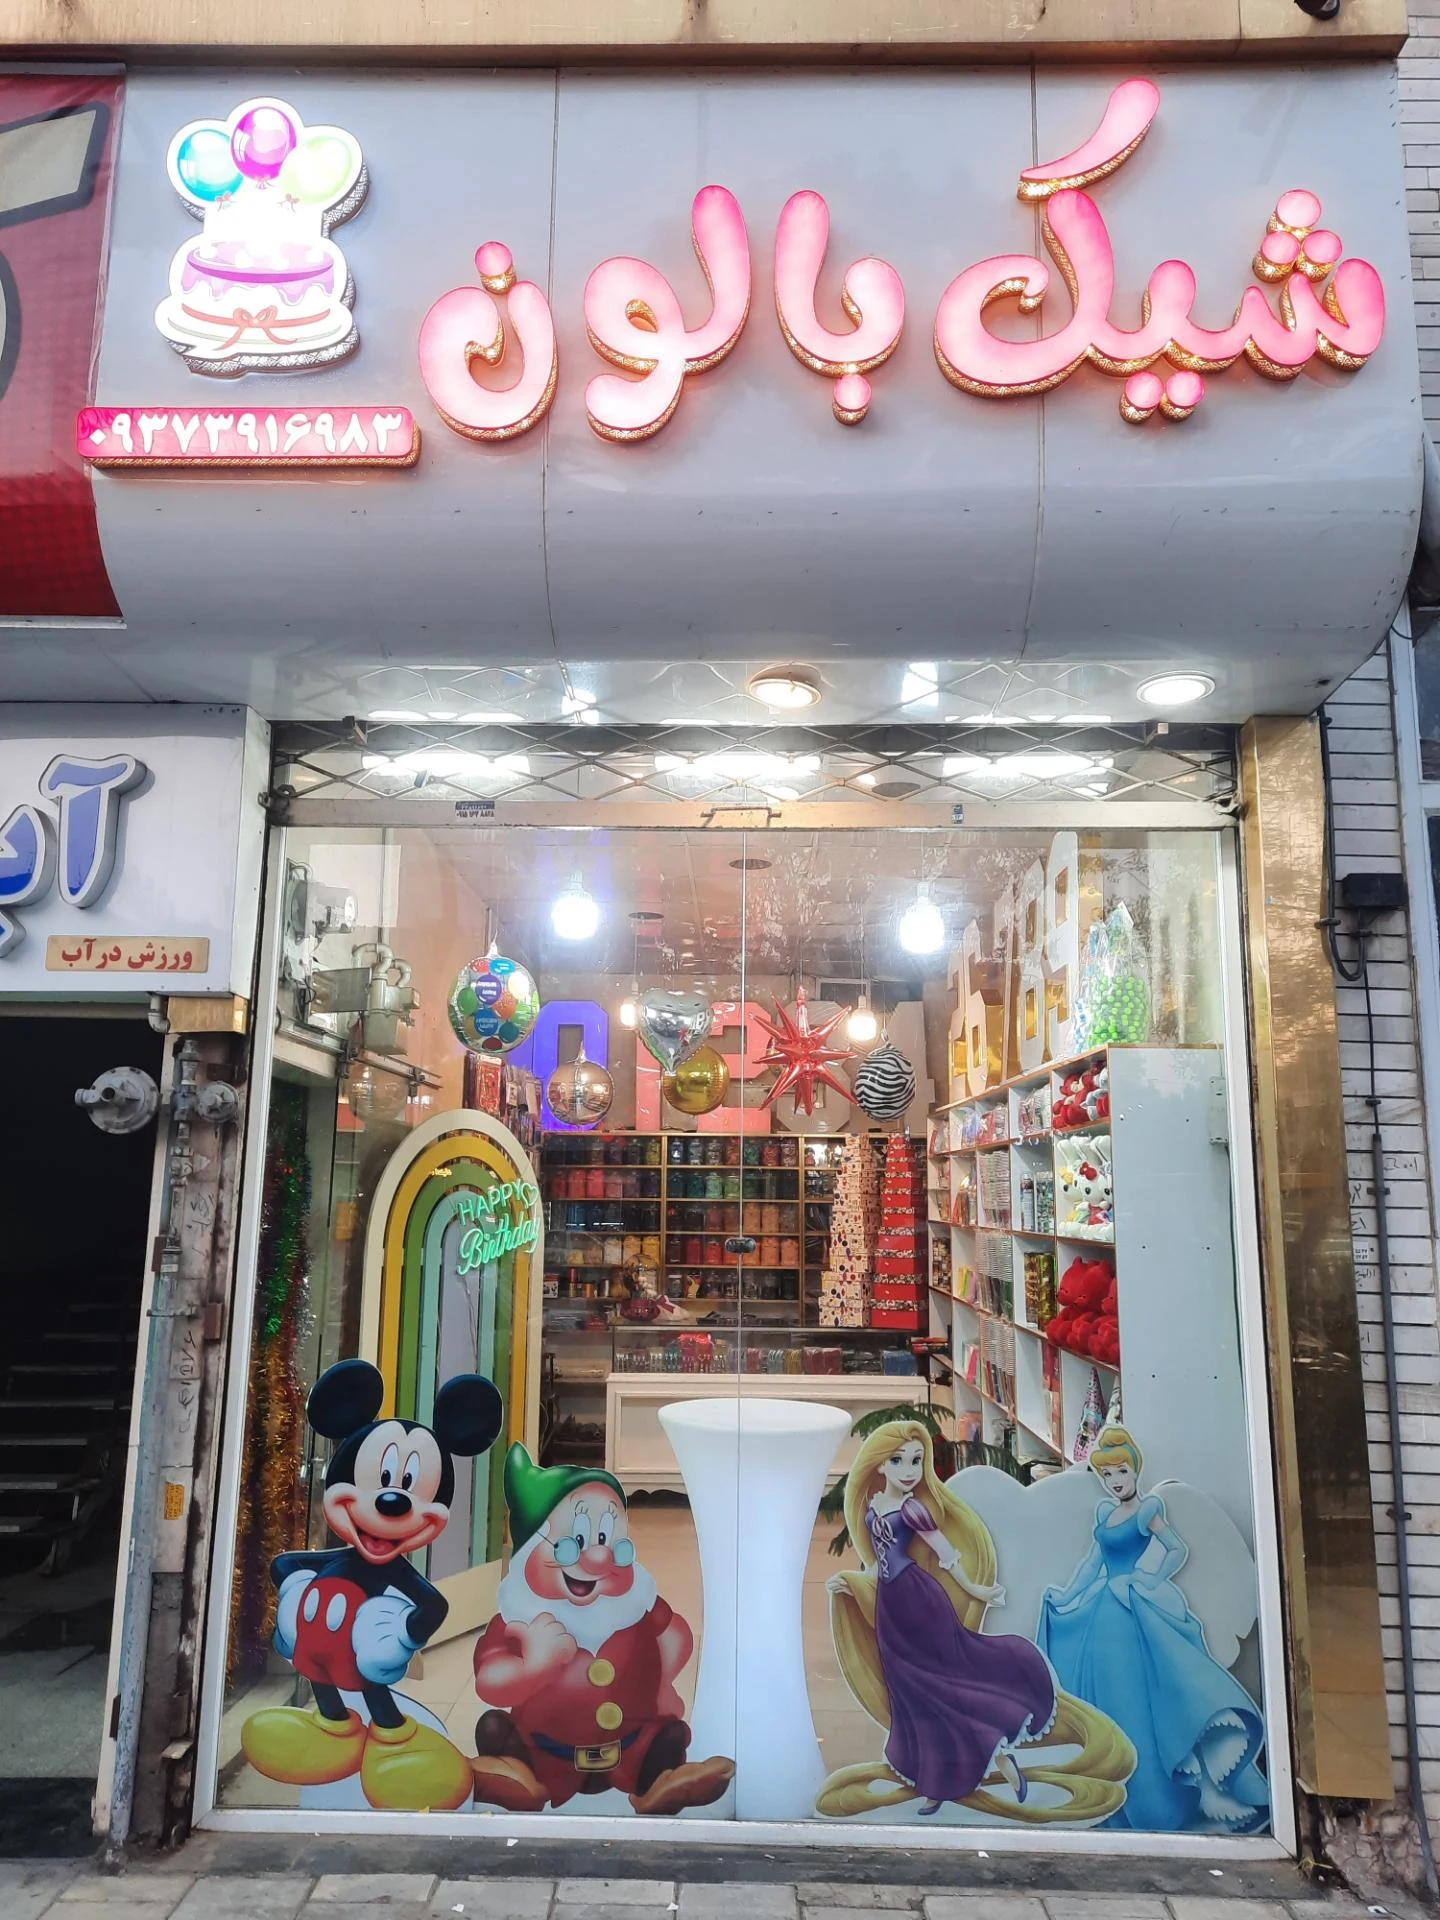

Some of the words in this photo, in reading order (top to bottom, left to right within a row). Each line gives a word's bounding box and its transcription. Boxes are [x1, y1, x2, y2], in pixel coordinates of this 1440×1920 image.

[418, 185, 905, 445] بالون
[88, 412, 403, 455] ۰۹۳۷۳۹۱۶۹۸۳
[61, 938, 97, 968] آب
[95, 945, 122, 970] در
[127, 942, 193, 970] ورزش
[458, 1178, 523, 1226] HAPPY
[457, 1209, 541, 1276] Birthday
